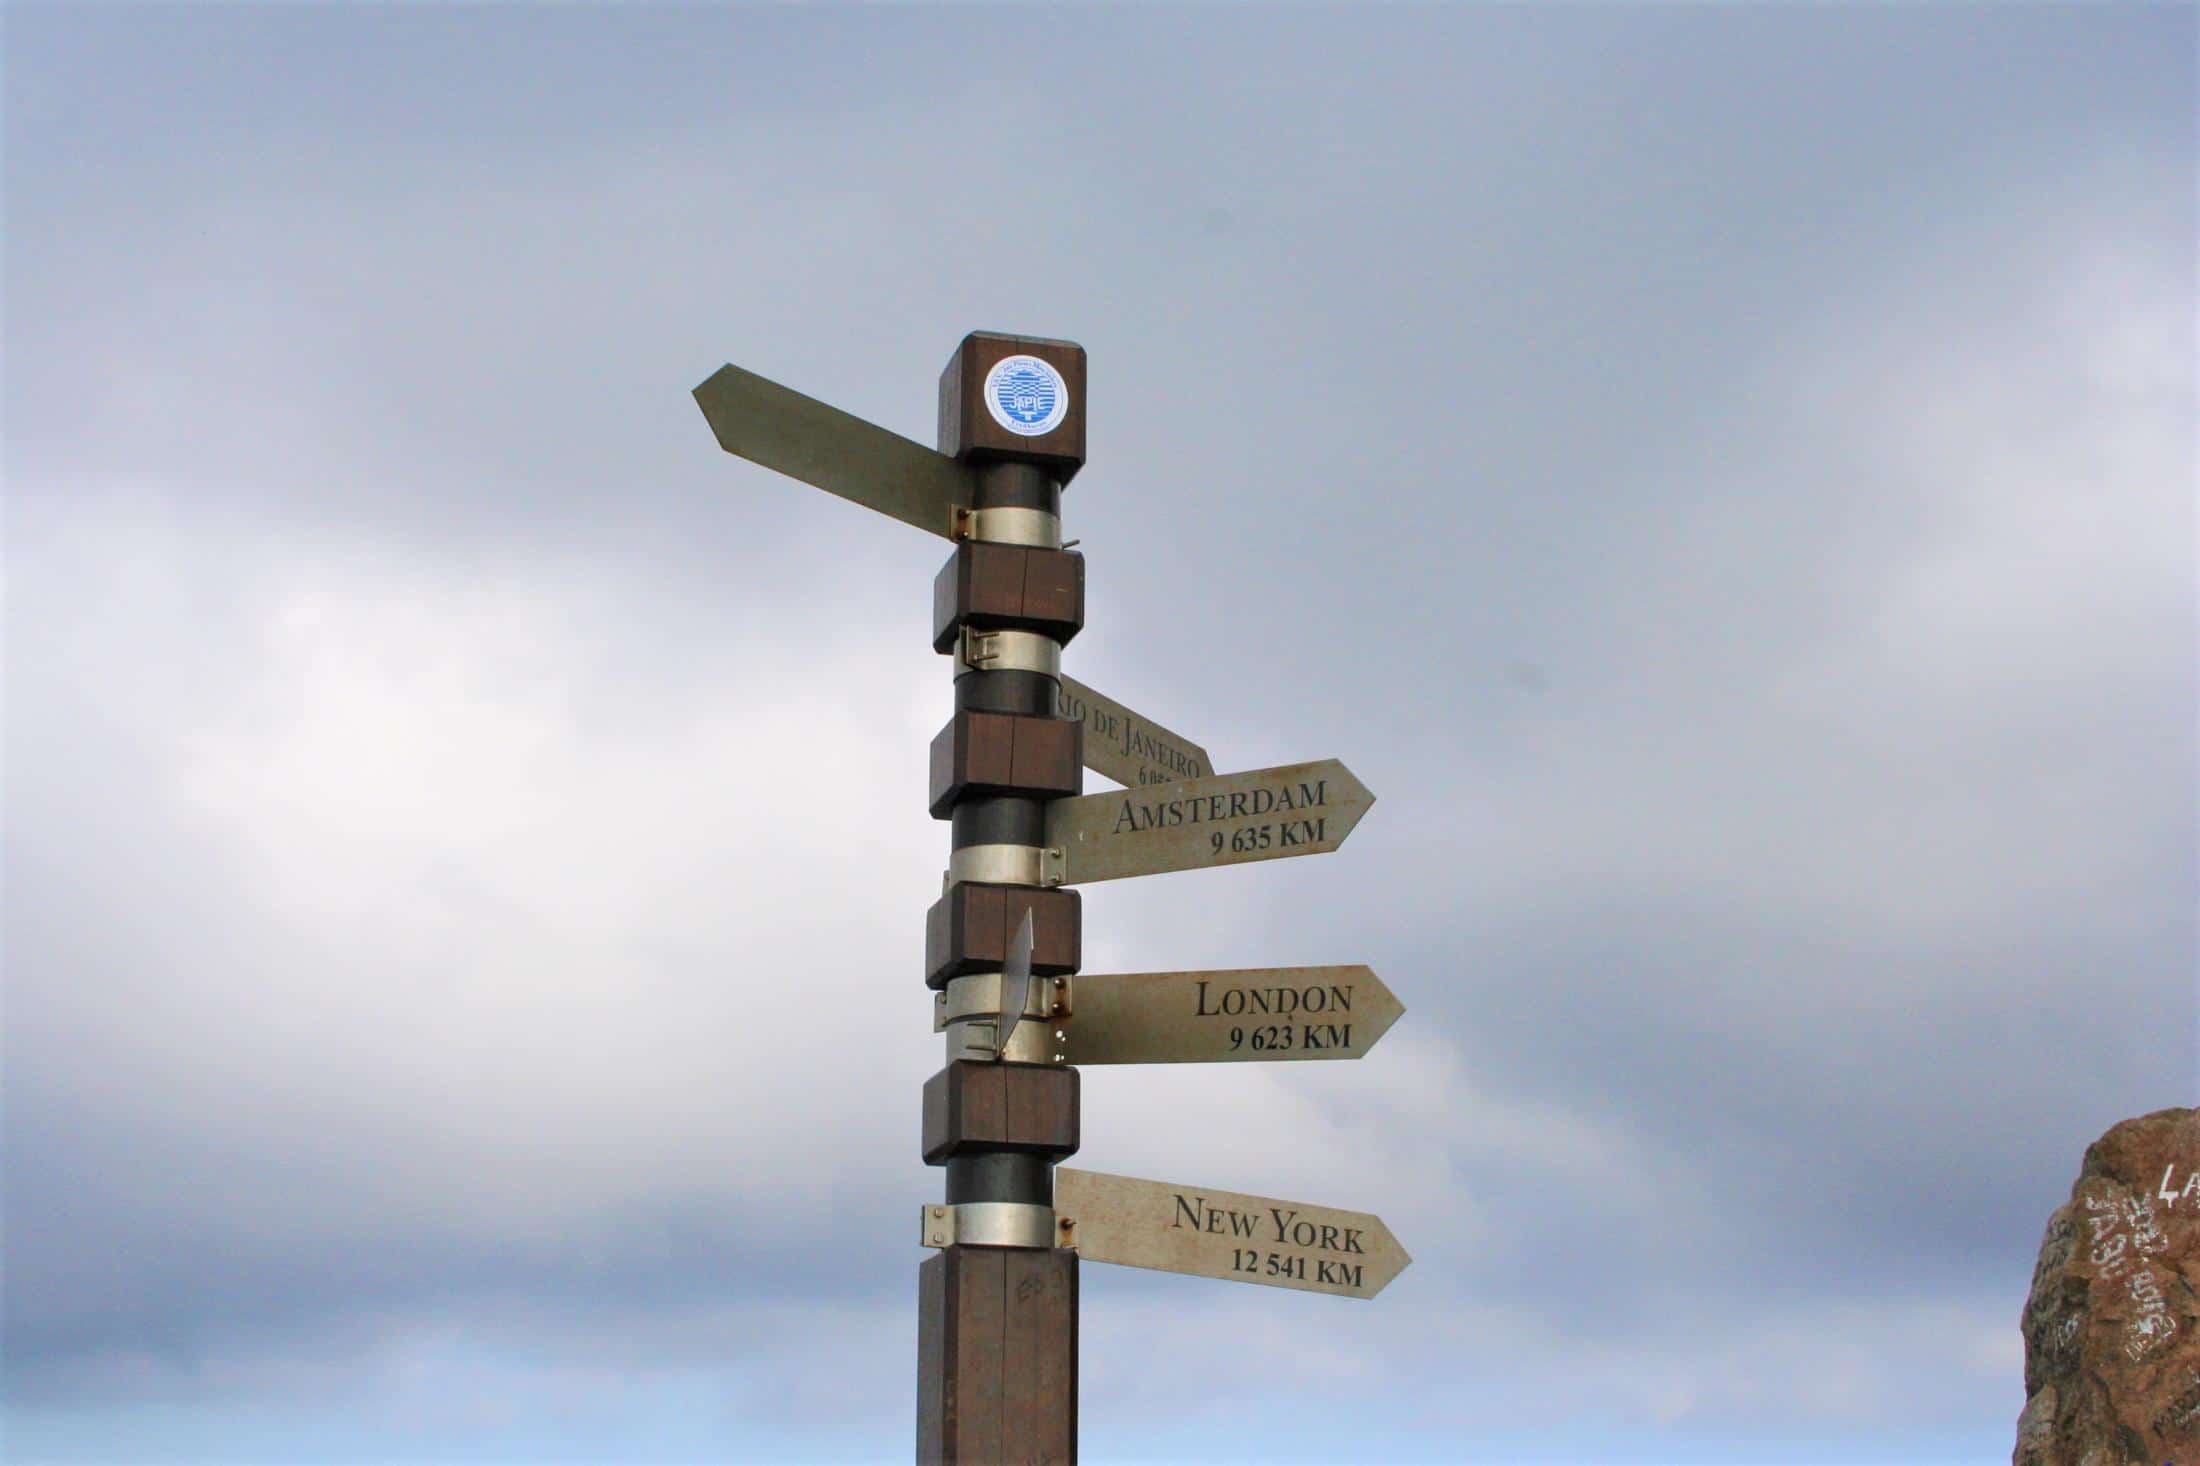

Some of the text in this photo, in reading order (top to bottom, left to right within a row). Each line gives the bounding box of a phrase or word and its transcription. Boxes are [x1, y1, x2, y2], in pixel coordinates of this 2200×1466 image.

[1093, 708, 1119, 740] DE
[1120, 718, 1200, 779] JANEIRO
[1112, 780, 1328, 834] AMSTERDAM
[1211, 818, 1326, 856] 9 635 KM
[1195, 981, 1355, 1017] LONDON
[1230, 1023, 1352, 1051] 9 623 KM
[1172, 1194, 1366, 1255] NEW YORK
[1232, 1248, 1364, 1288] 12 541 KM
